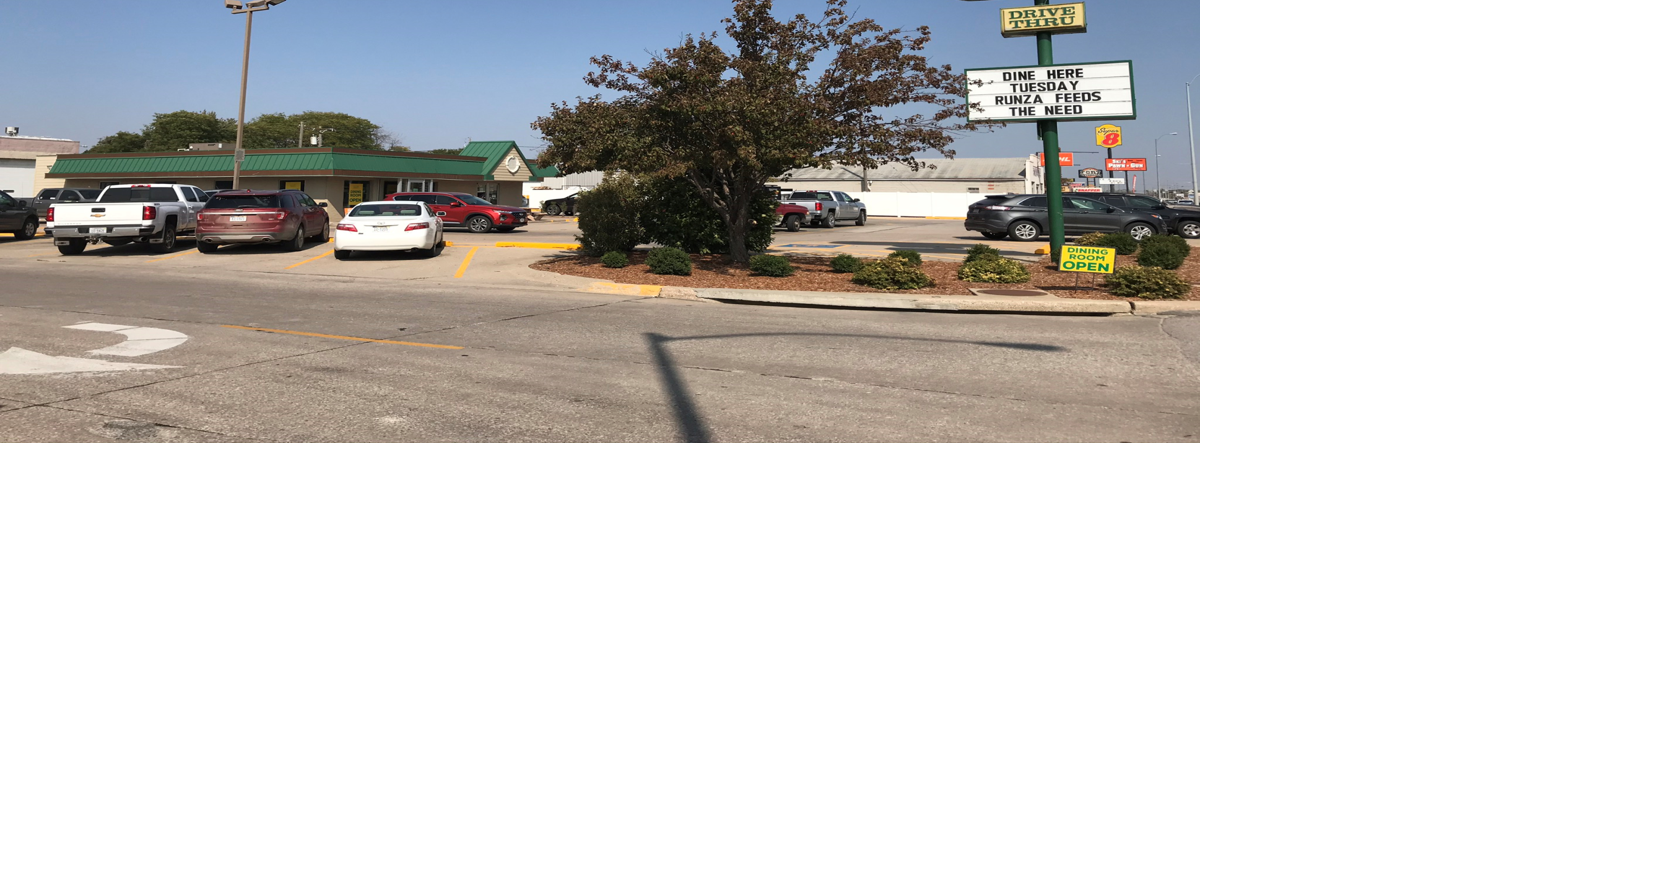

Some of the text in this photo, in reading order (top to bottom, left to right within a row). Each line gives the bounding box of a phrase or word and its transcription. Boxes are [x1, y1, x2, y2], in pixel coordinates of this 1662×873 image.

[1008, 6, 1075, 19] DRIVE
[1009, 16, 1075, 29] THRU
[1002, 68, 1083, 81] DINE HERE
[1010, 81, 1079, 92] TUESDAY
[995, 92, 1101, 105] RUNZA FEEDS
[1009, 105, 1082, 116] THE NEED
[1102, 133, 1119, 145] 8
[1067, 247, 1108, 255] DINING
[1062, 261, 1110, 272] OPEN
